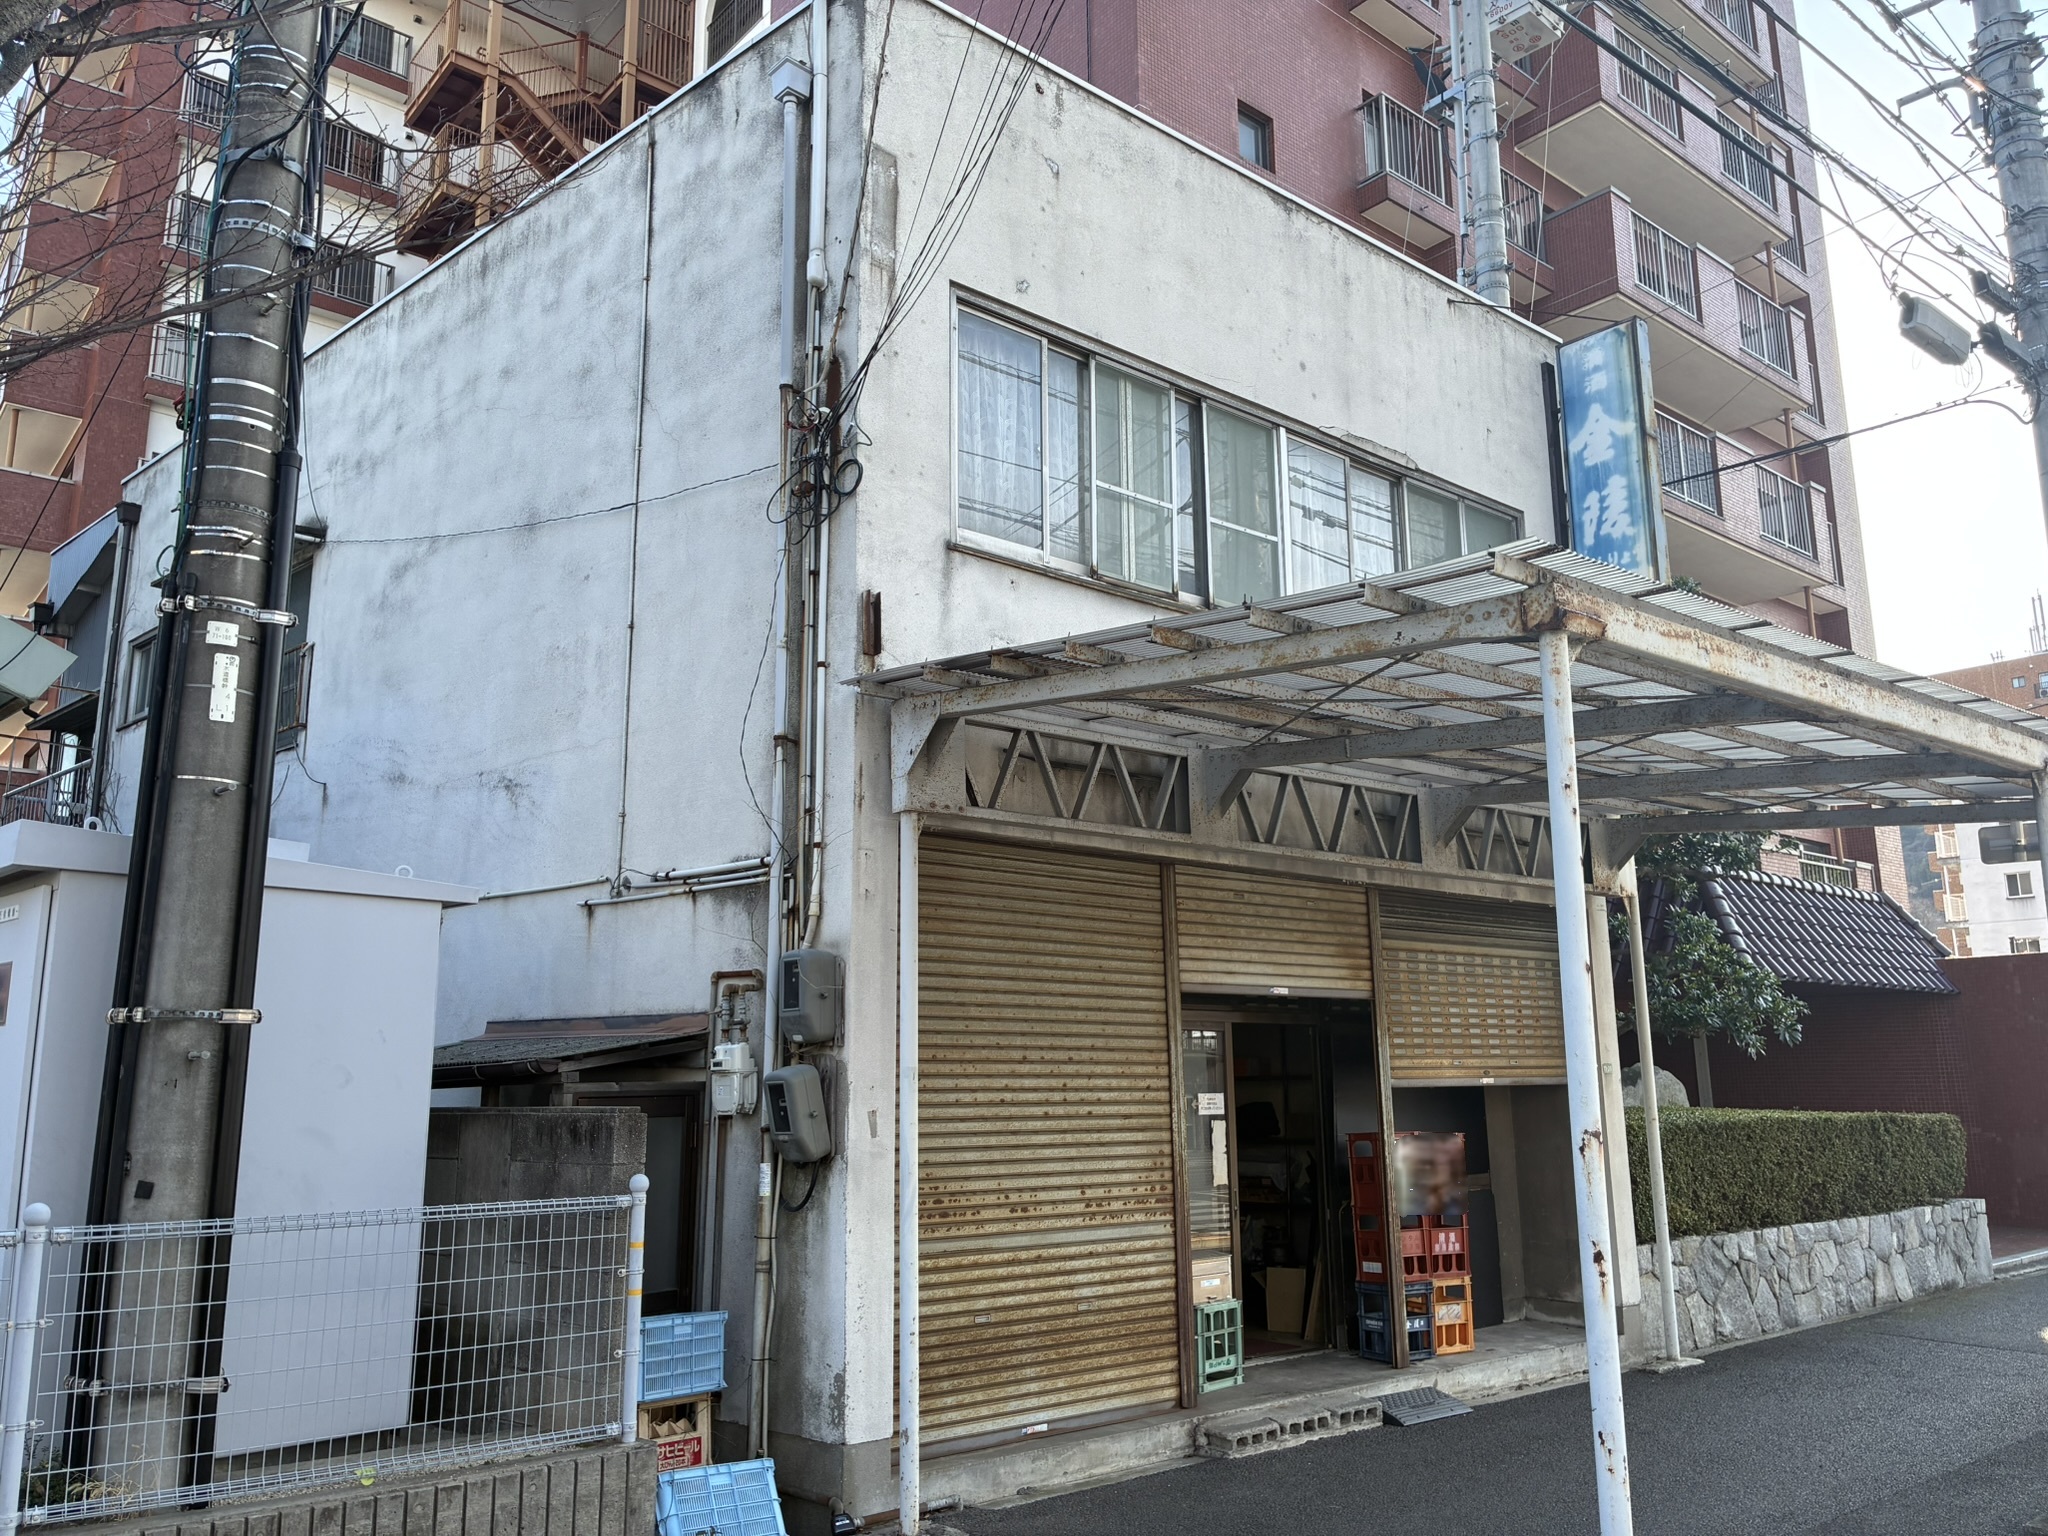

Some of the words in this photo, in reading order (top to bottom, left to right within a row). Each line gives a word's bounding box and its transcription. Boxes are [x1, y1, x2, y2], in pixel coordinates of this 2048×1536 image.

[657, 1440, 700, 1459] サヒビール
